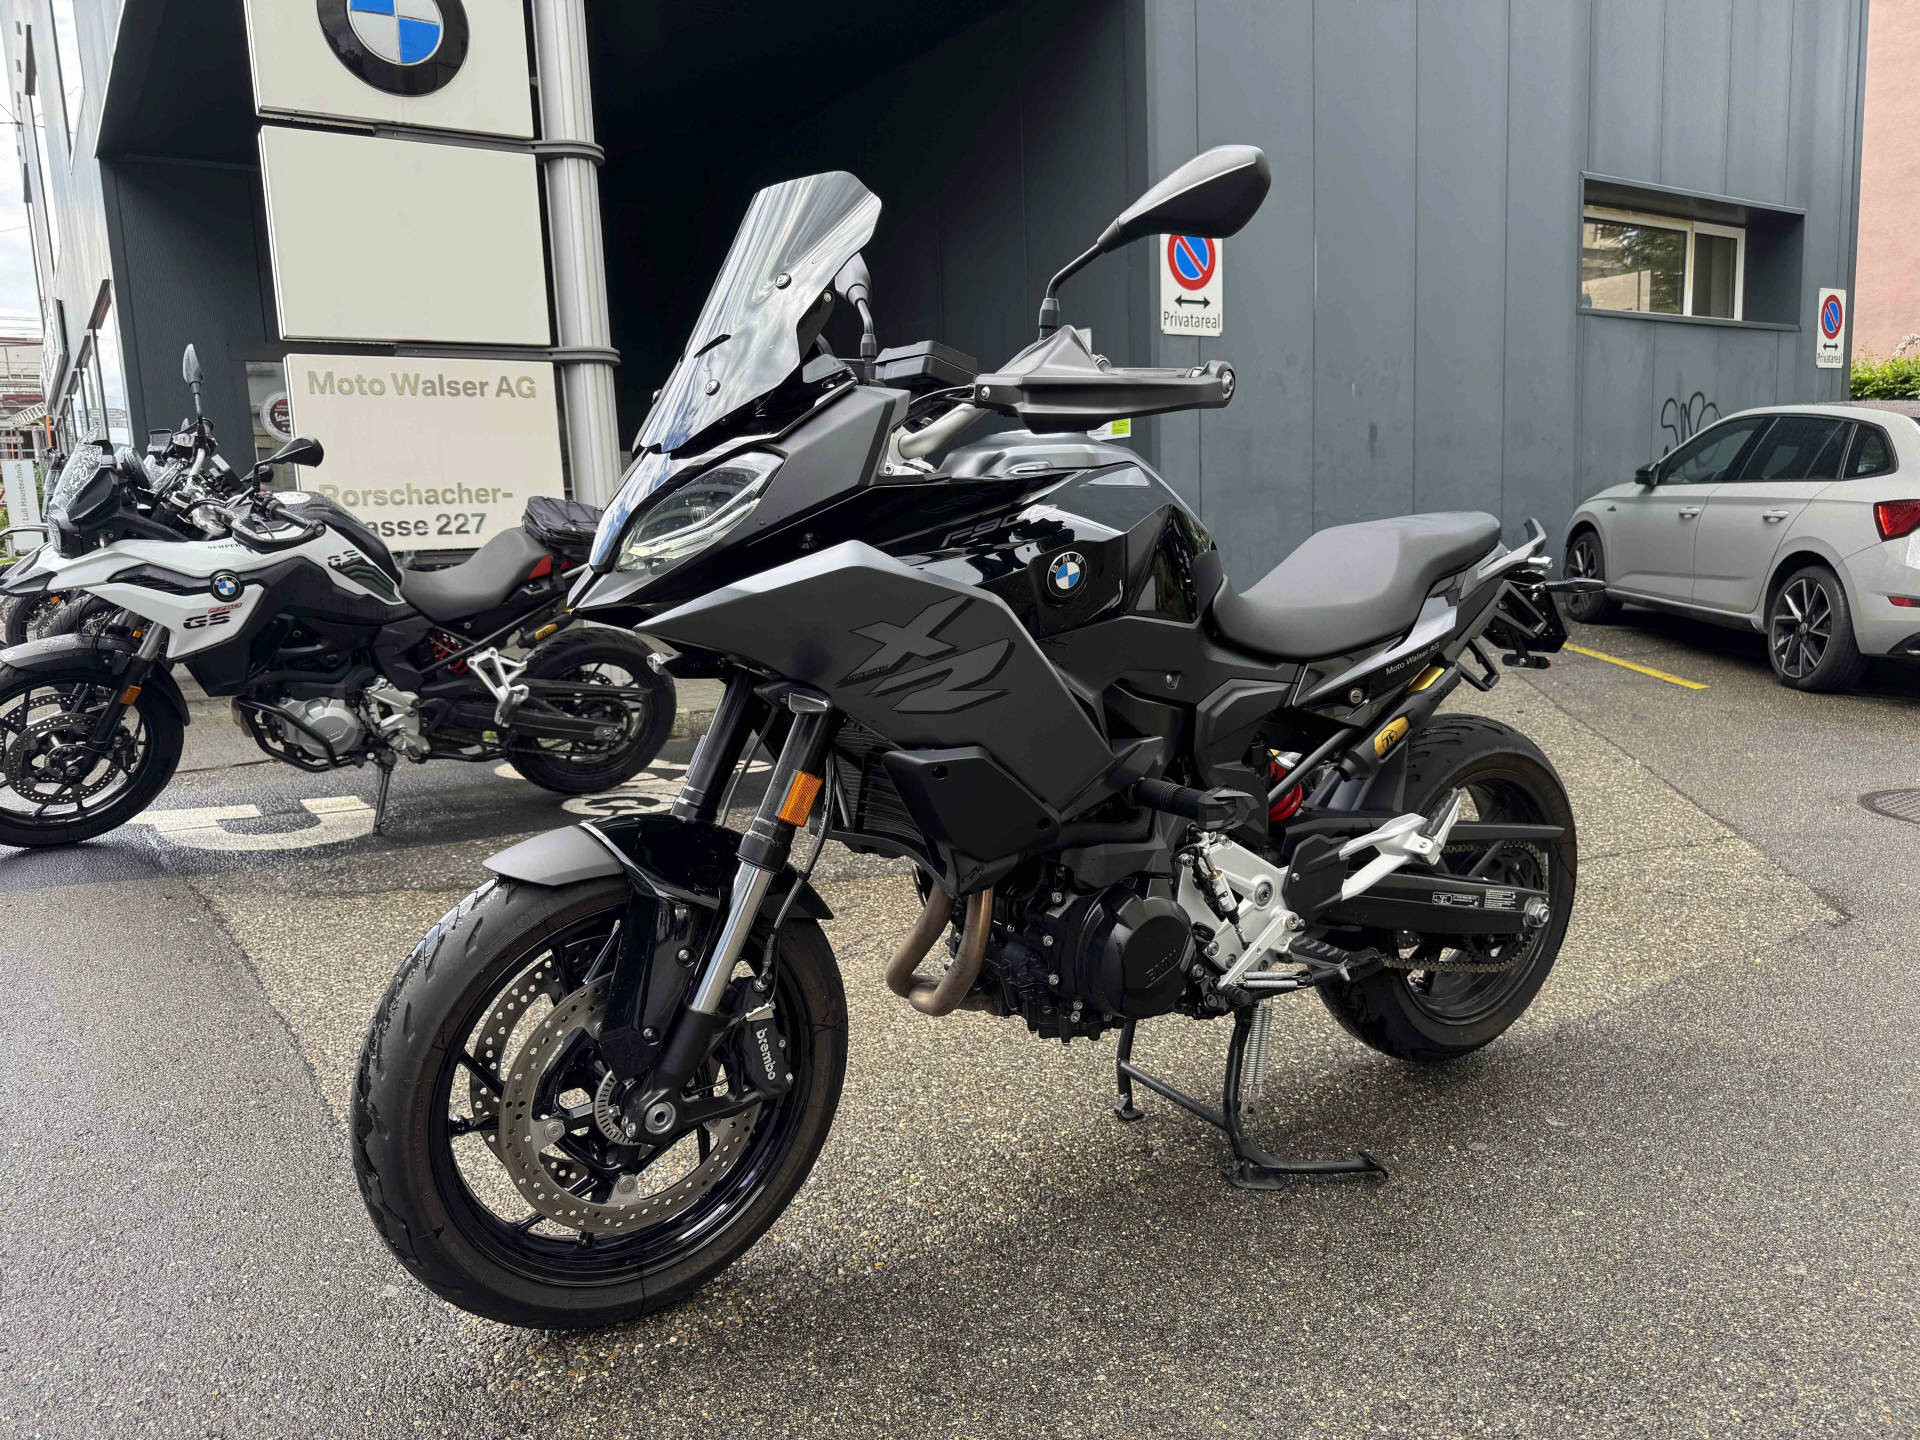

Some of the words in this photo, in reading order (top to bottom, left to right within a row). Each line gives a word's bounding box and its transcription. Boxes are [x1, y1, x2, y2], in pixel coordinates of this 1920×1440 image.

[1163, 311, 1220, 329] Privatareal
[307, 370, 386, 396] Moto
[391, 372, 489, 397] Walser
[495, 375, 537, 398] AG
[318, 482, 513, 507] Rorschacher-
[364, 519, 429, 538] asse
[435, 513, 487, 536] 227
[183, 611, 231, 630] GS
[1385, 662, 1405, 676] Moto
[1406, 649, 1429, 664] Walser
[1429, 641, 1441, 653] AG
[756, 1027, 776, 1080] brembo
